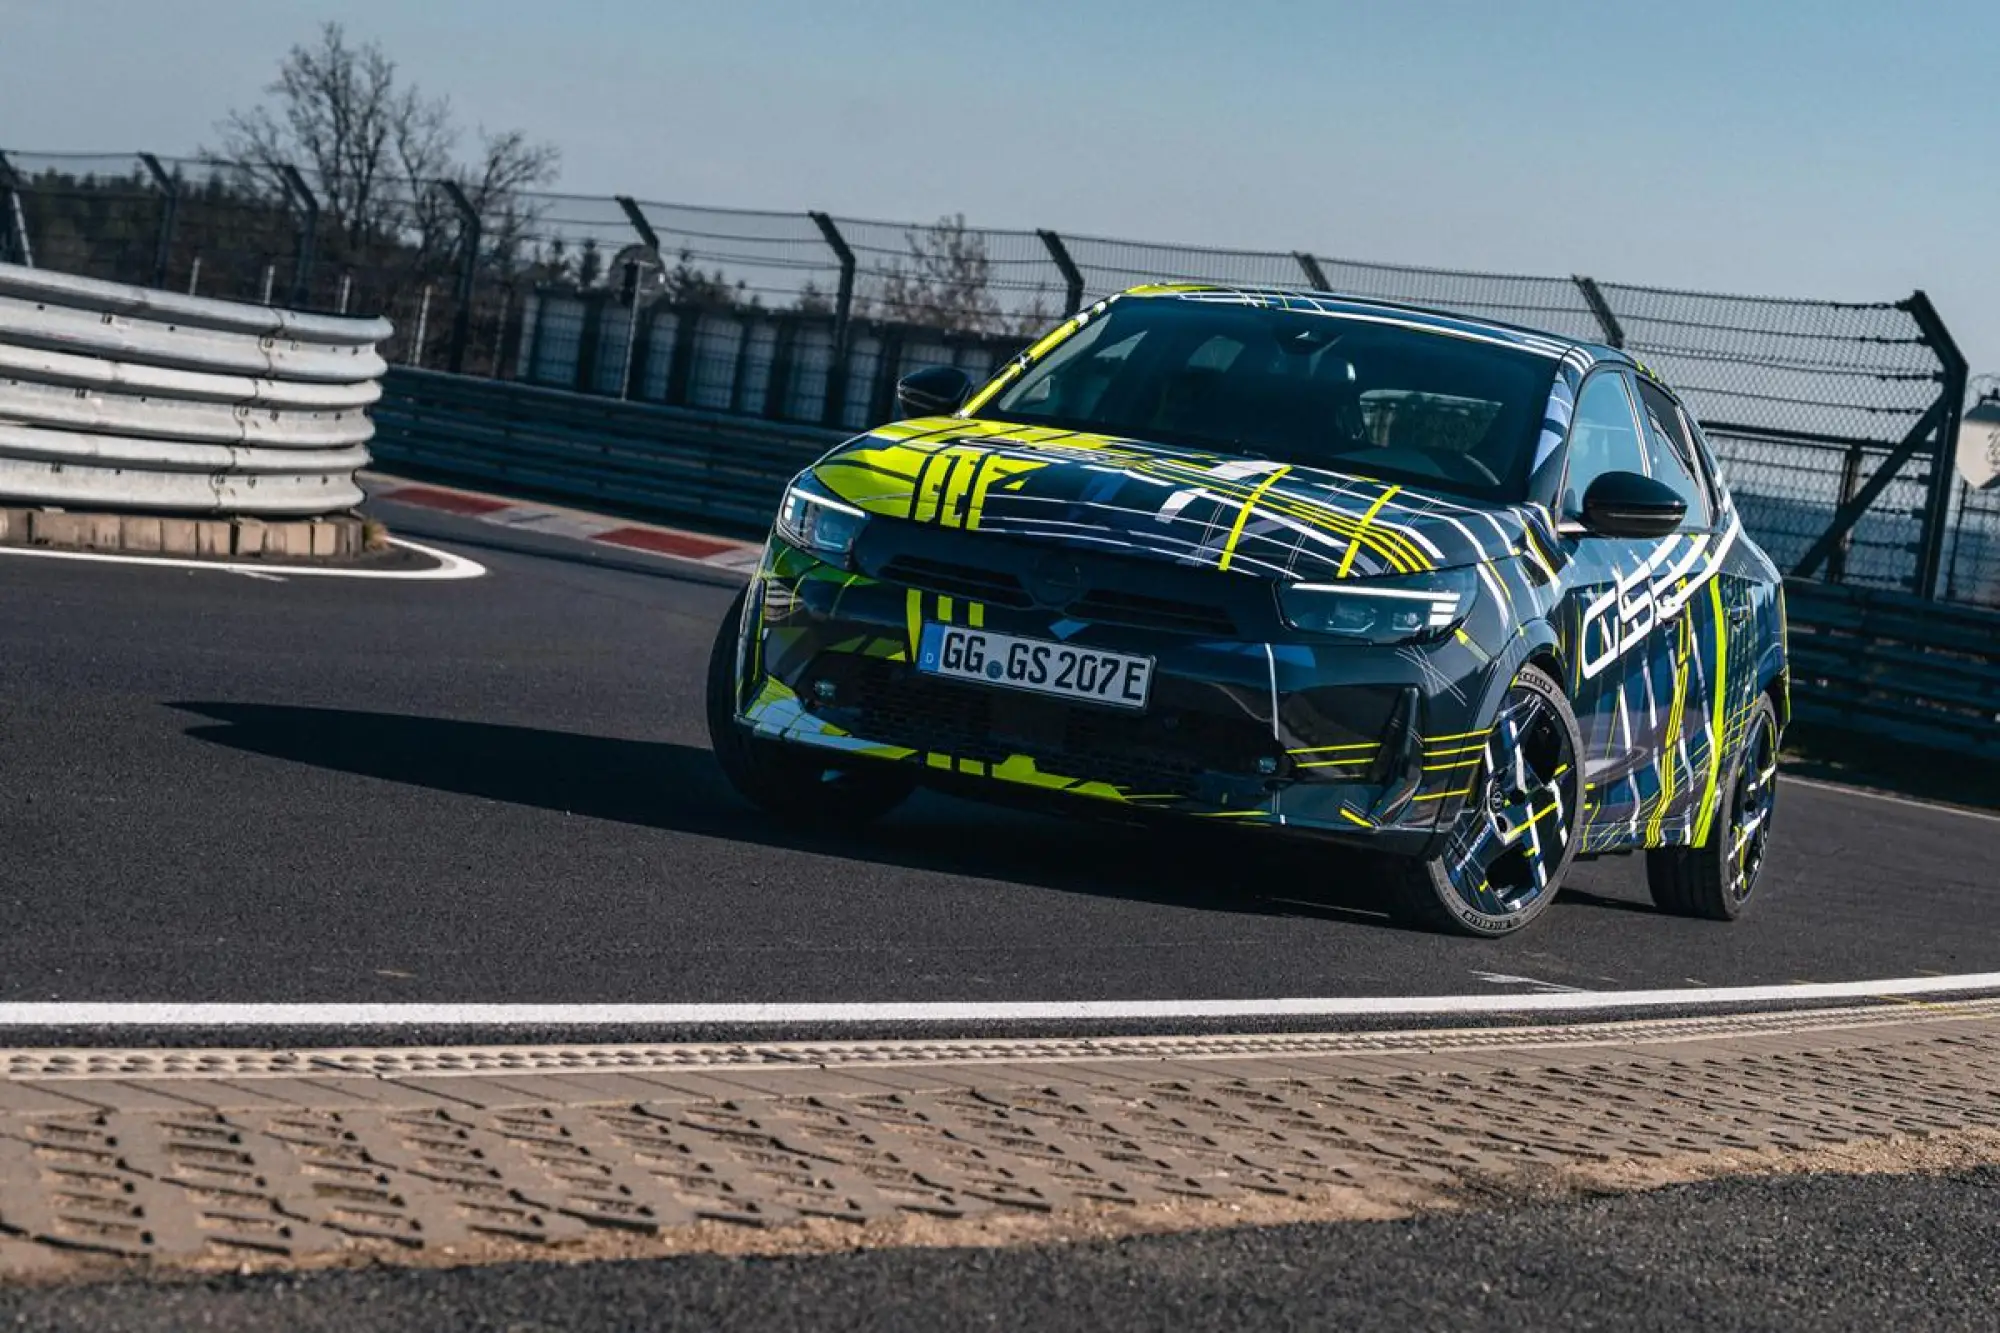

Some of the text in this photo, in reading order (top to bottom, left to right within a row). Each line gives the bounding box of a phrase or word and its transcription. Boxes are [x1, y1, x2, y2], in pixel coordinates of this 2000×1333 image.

[926, 652, 934, 664] D
[942, 632, 986, 674] GG
[1006, 642, 1051, 684] GS
